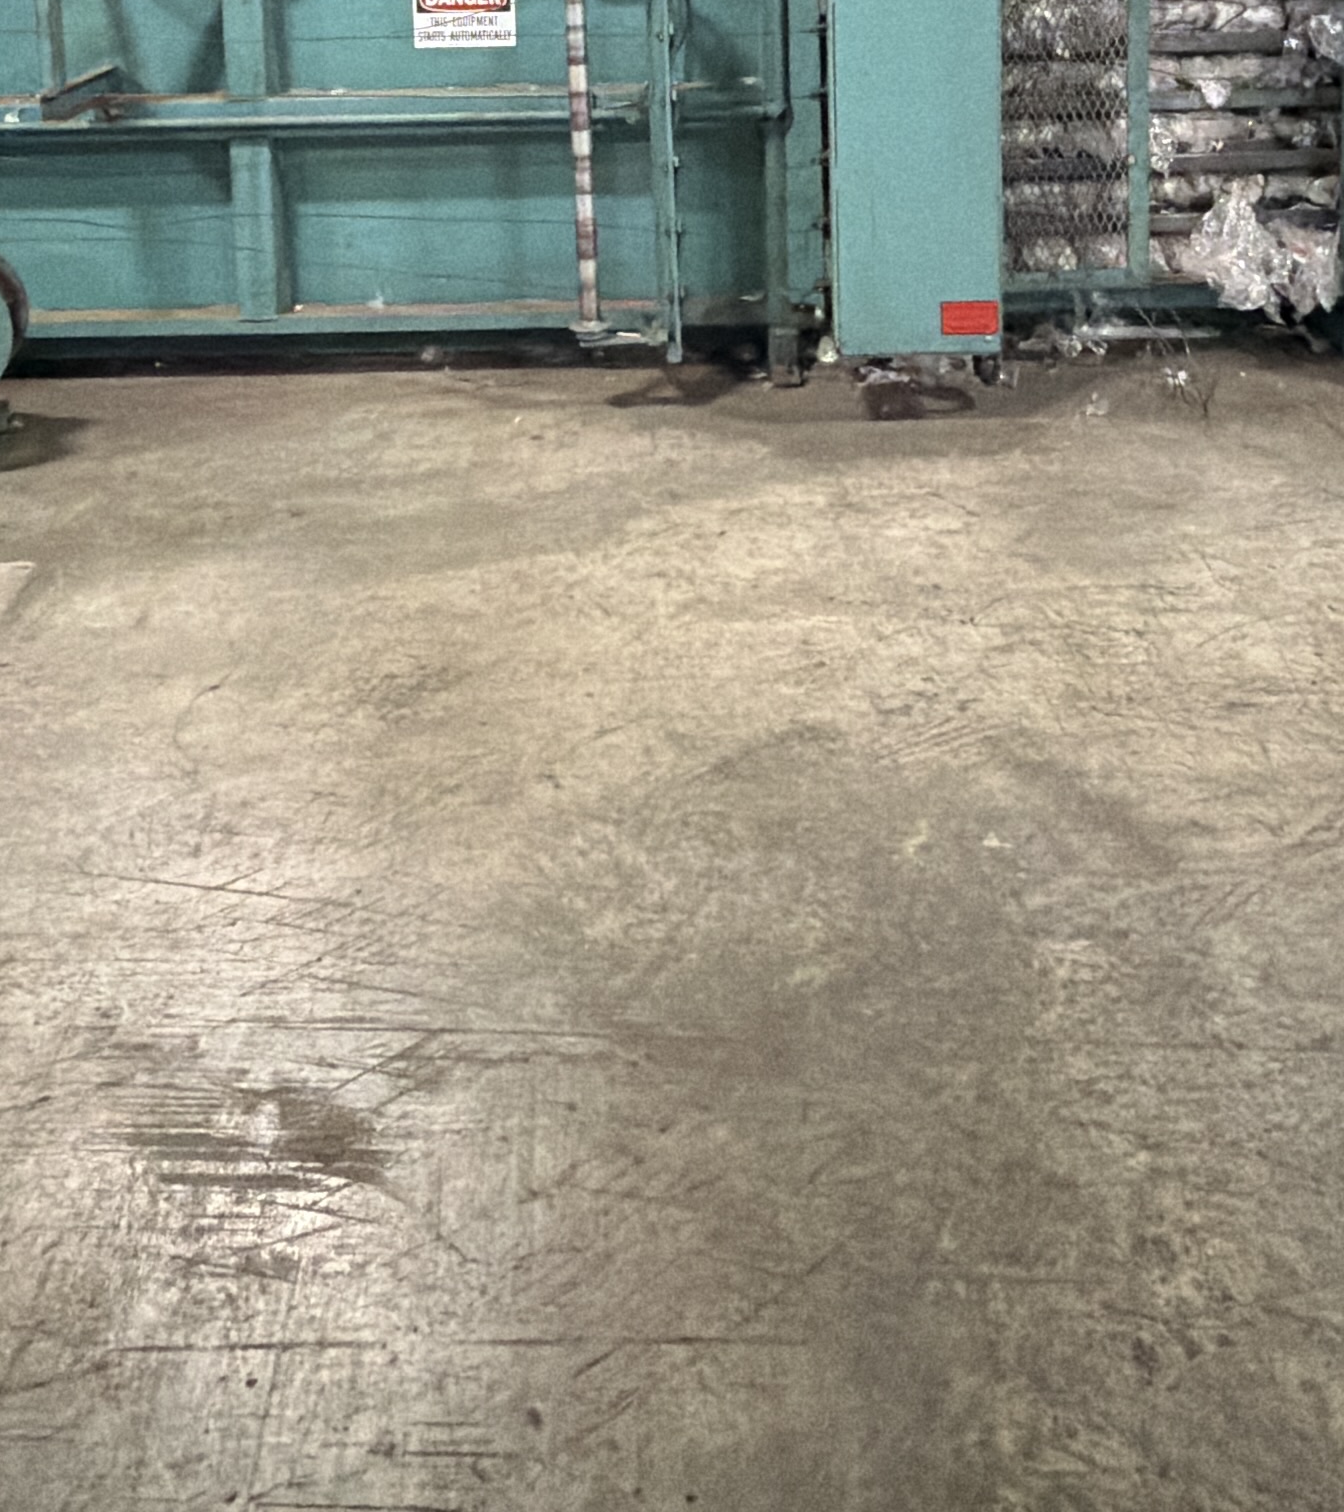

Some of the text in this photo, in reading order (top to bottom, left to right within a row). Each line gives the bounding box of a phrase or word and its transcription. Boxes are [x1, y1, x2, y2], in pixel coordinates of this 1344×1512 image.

[430, 16, 498, 28] THIS EQUIPMENT
[418, 29, 512, 43] STARTS AUTOMATICALLY
